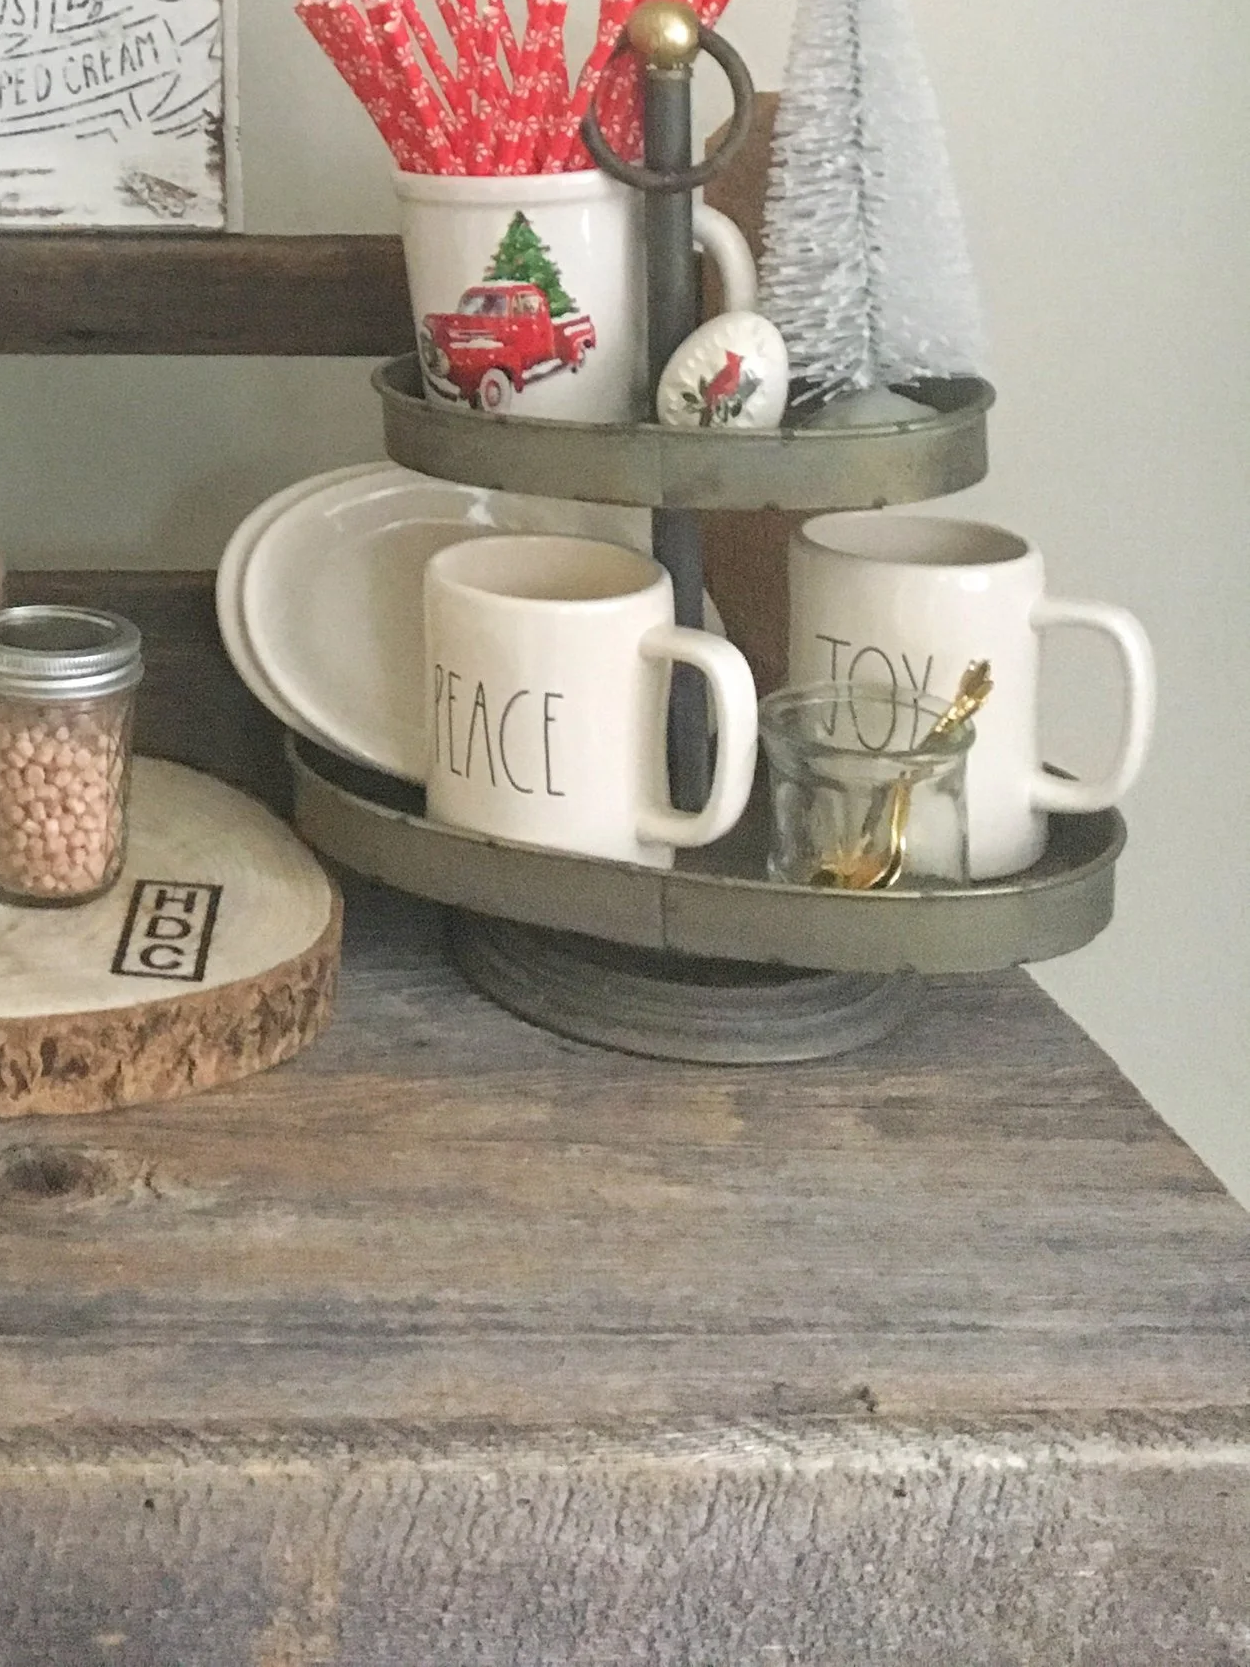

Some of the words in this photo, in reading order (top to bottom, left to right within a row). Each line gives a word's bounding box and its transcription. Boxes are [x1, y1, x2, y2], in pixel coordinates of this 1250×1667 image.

[63, 34, 160, 97] CREAM
[433, 663, 566, 797] PEACE
[815, 634, 934, 752] JOY
